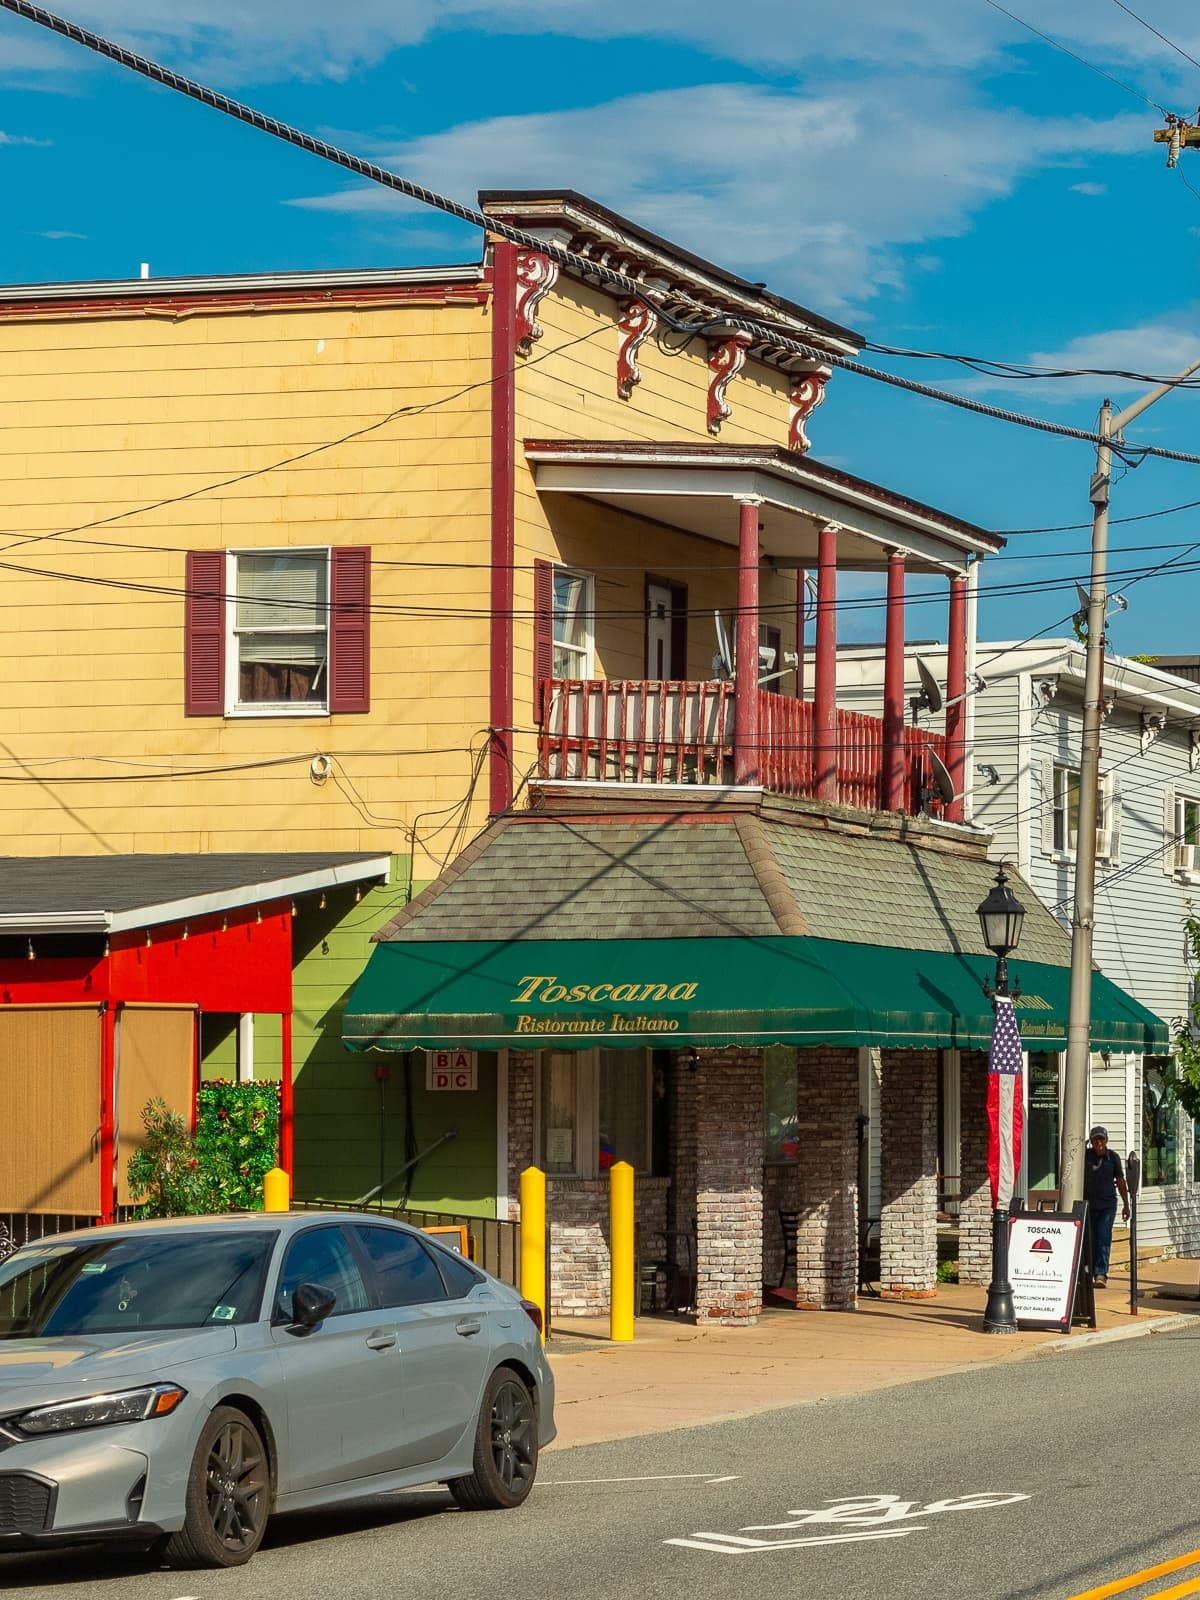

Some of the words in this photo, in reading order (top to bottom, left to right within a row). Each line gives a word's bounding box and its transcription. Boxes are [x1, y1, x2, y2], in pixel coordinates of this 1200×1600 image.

[510, 976, 699, 1004] Toscana
[514, 1015, 606, 1033] Ristorante
[609, 1013, 680, 1032] Italiano
[1027, 1226, 1061, 1234] TOSCANA
